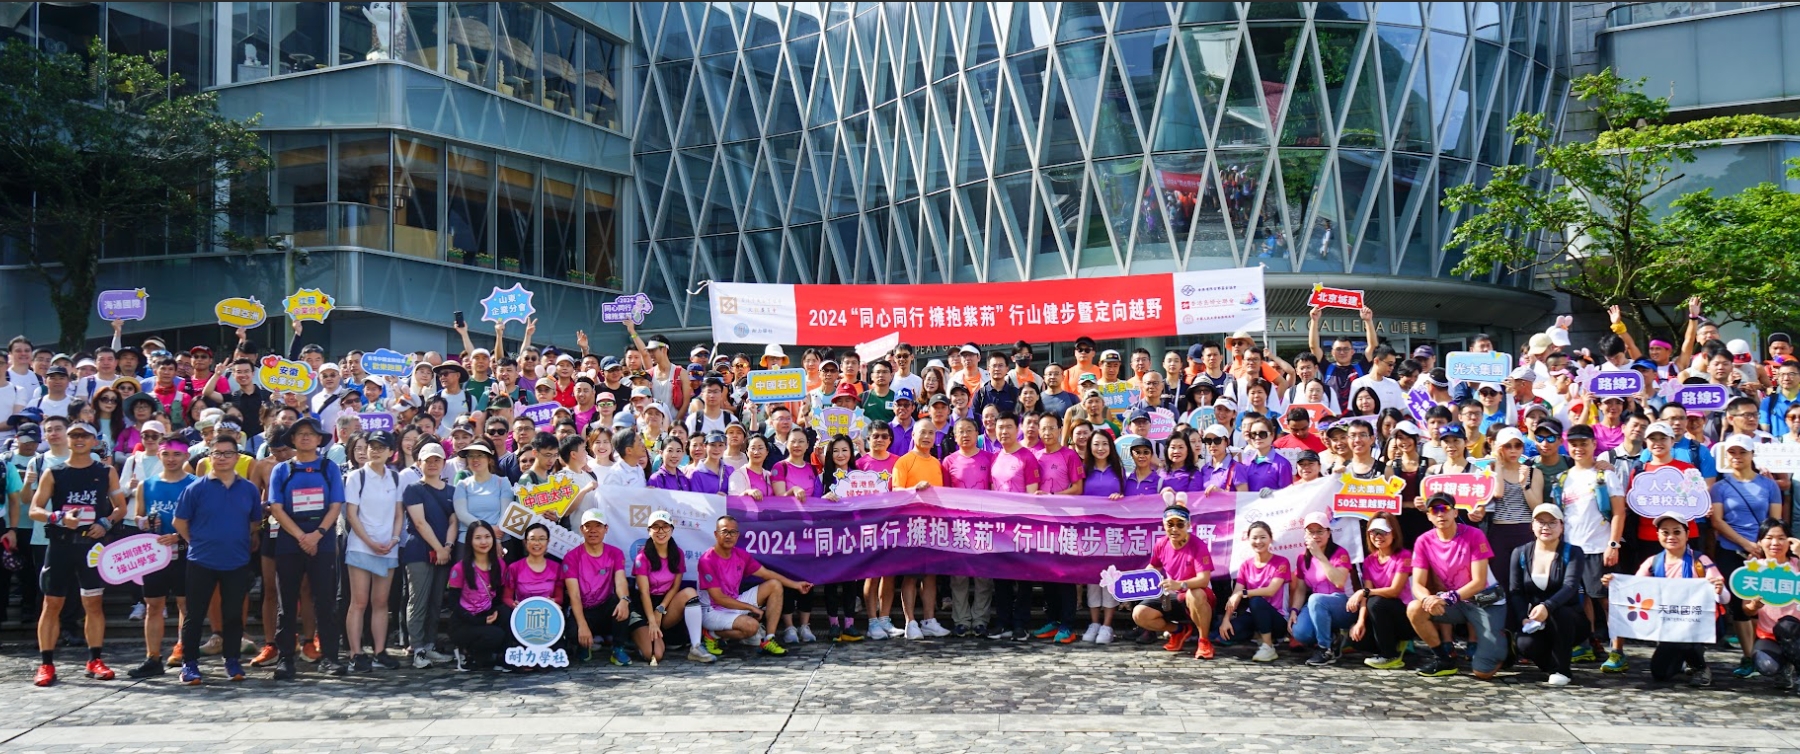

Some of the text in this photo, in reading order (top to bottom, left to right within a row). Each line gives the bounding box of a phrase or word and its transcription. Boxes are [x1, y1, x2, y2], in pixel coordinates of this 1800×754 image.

[103, 298, 142, 310] 海通國際
[498, 294, 517, 304] 山東
[1317, 292, 1358, 306] 北京城建
[222, 305, 261, 321] 工銀亞洲
[491, 303, 527, 316] 企業分會
[809, 309, 848, 327] 2024
[1009, 298, 1163, 326] 行山健步暨定向越野
[1266, 318, 1297, 333] EAK
[279, 366, 299, 377] 安徽
[1453, 363, 1504, 377] 光大集團
[269, 376, 306, 389] 企業分會
[755, 378, 798, 391] 中國石化
[1598, 378, 1638, 392] 路線2
[1682, 391, 1722, 405] 路線5
[827, 413, 849, 425] 中國
[1347, 484, 1386, 495] 光大集團
[1429, 482, 1486, 497] 中銀香港
[1649, 480, 1675, 492] 人大
[523, 486, 575, 509] 中國太平
[1337, 499, 1397, 510] 50公里越野組
[1636, 495, 1698, 507] 香港校友會
[745, 531, 797, 555] 2024
[112, 543, 154, 563] 深圳健牧
[684, 550, 702, 561] 學社
[1122, 578, 1158, 594] 路線1
[1658, 604, 1703, 616] 天風國際
[524, 606, 551, 631] 耐
[508, 649, 566, 664] 耐力學社
